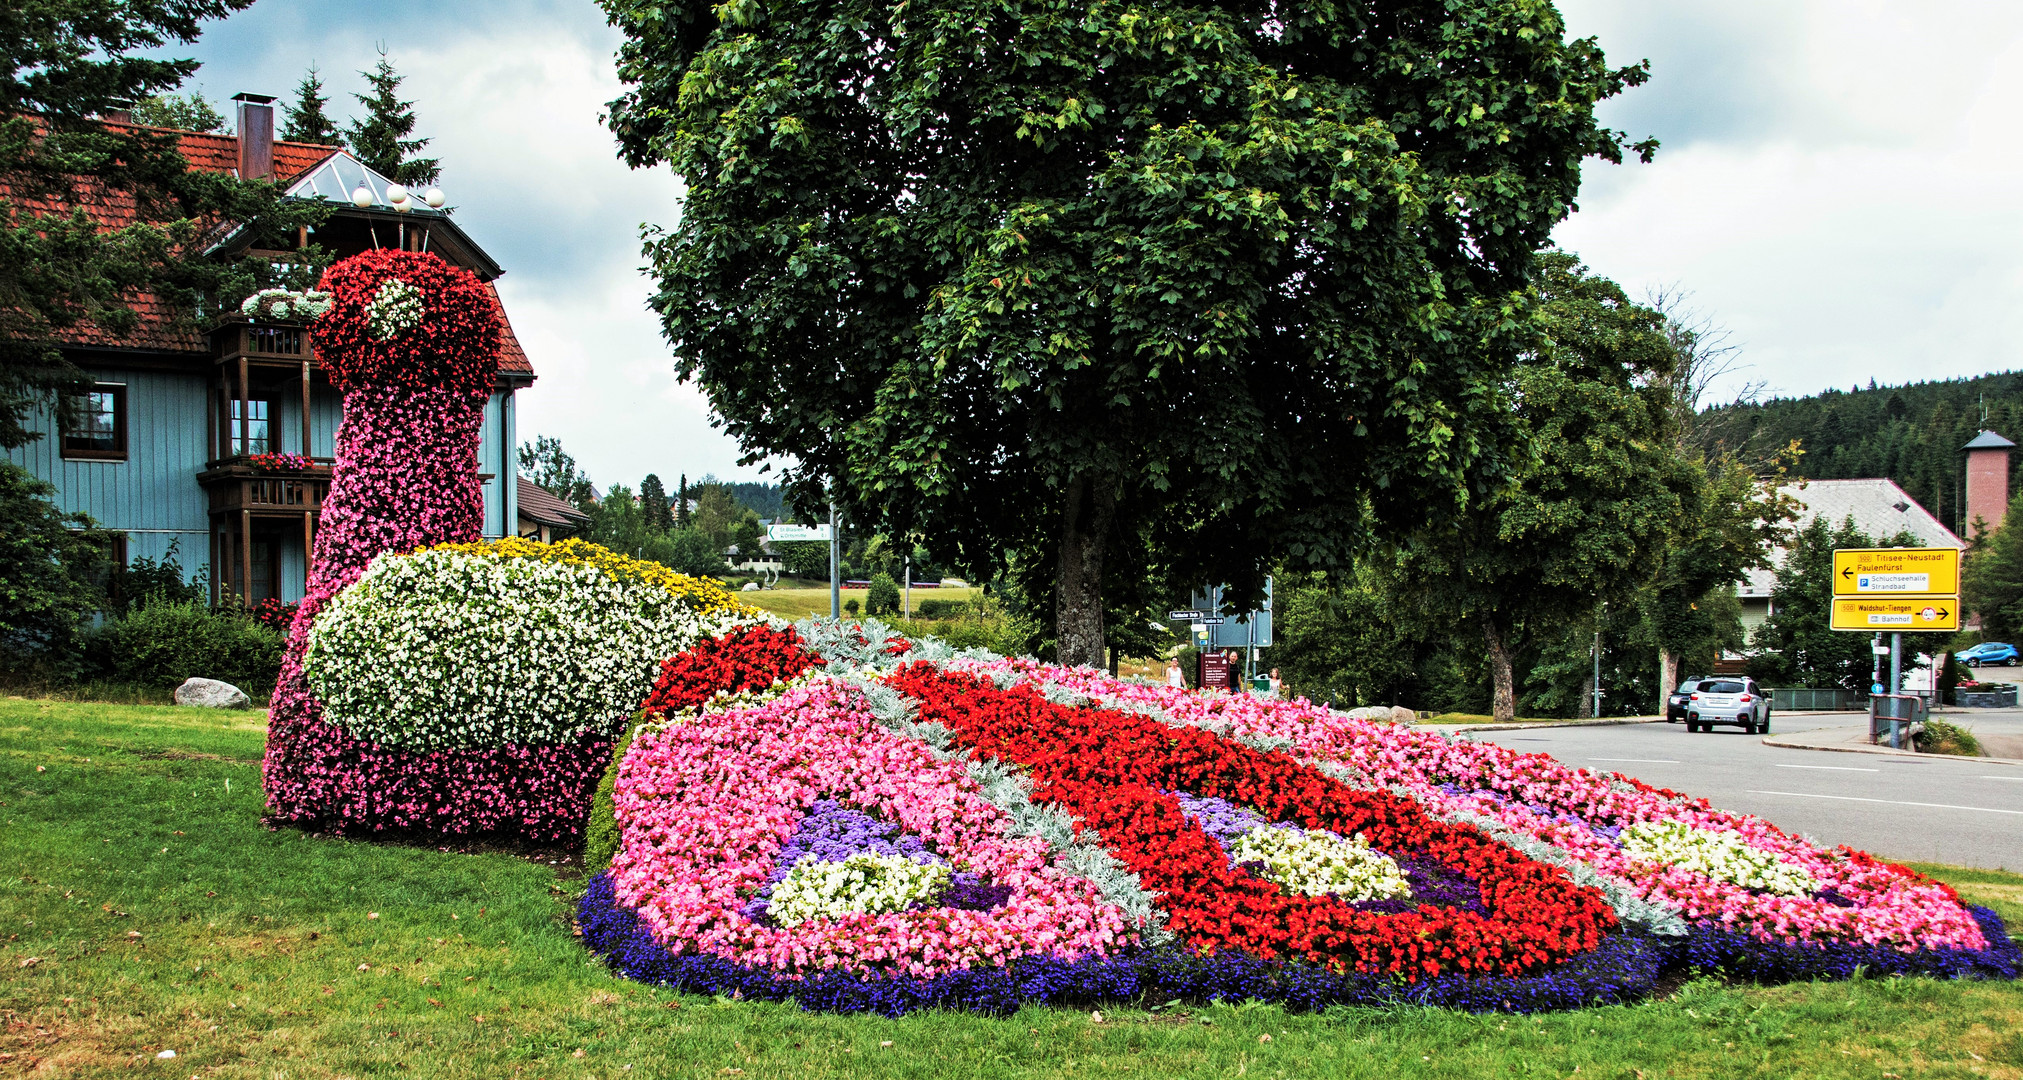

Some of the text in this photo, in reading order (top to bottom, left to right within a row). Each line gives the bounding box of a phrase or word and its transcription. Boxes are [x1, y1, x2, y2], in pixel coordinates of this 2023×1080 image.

[1876, 554, 1945, 562] Titisee-Neustadt
[1857, 563, 1903, 571] Faulenfürst
[1858, 604, 1912, 613] Waldshut-Tiengen
